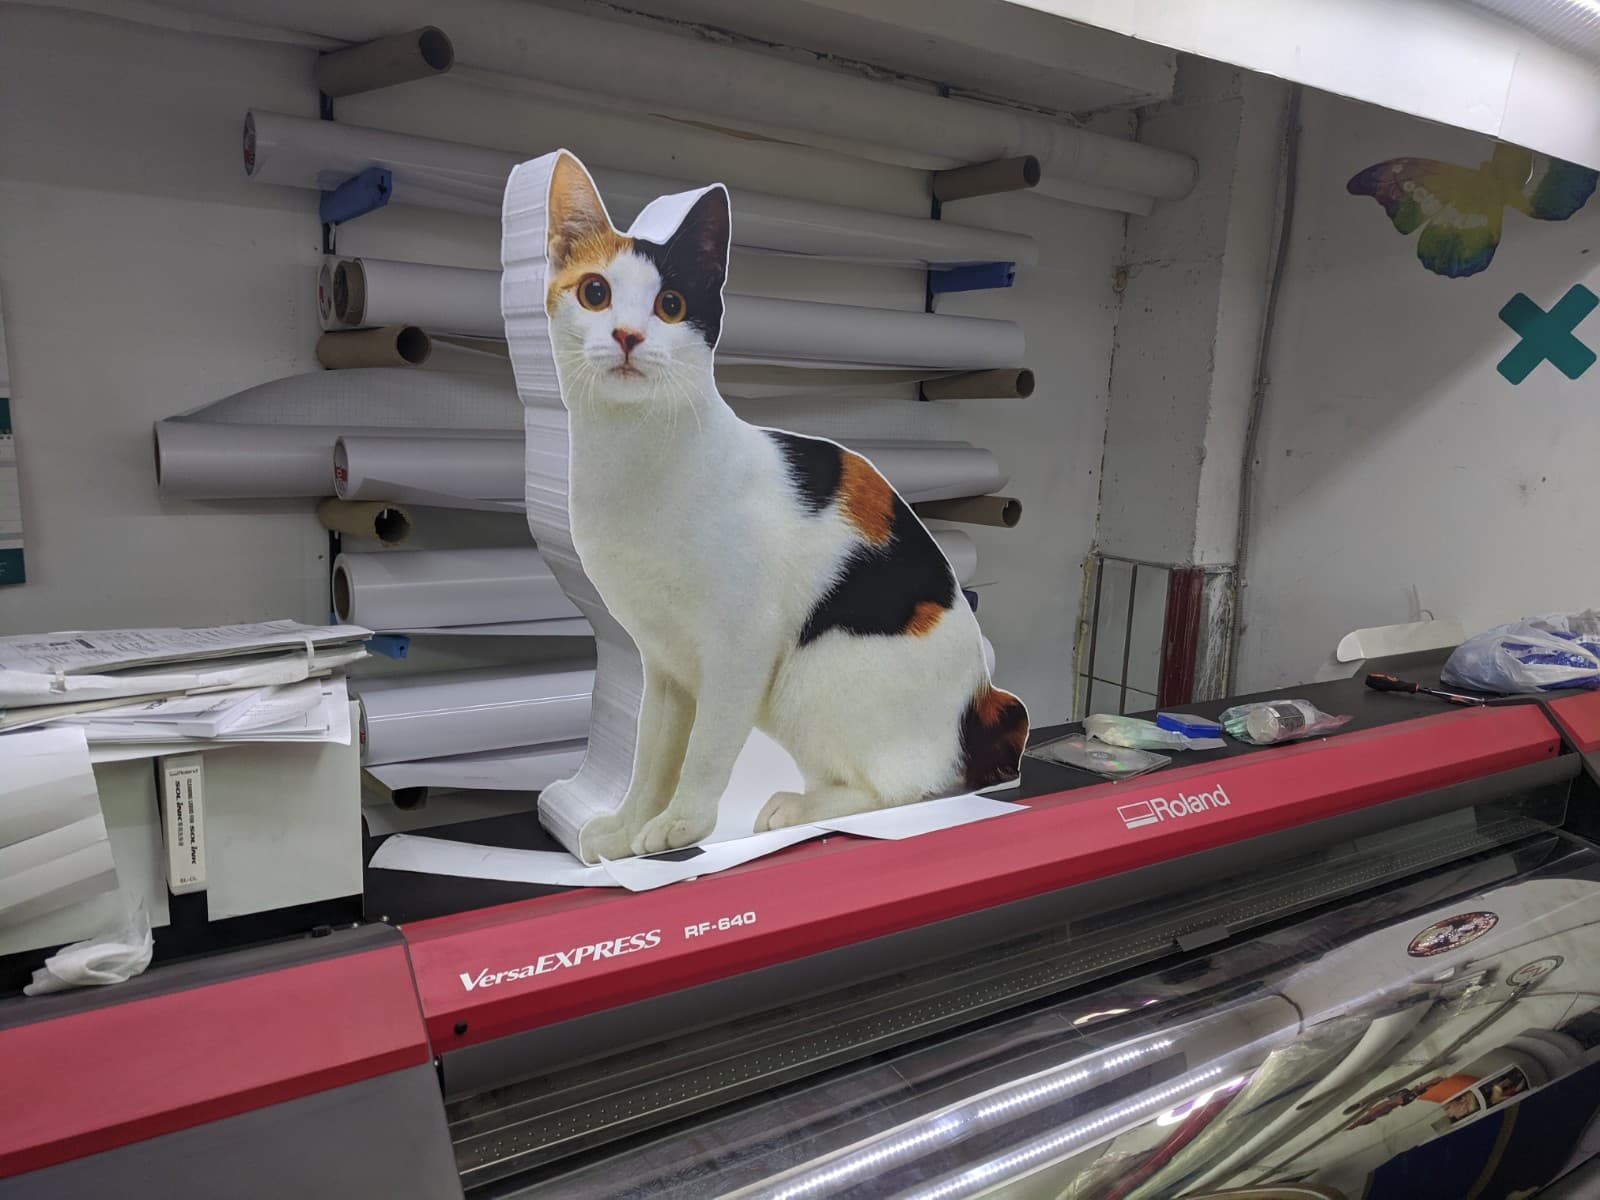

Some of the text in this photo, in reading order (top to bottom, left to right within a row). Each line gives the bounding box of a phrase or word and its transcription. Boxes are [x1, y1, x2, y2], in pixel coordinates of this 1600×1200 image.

[1150, 783, 1231, 822] Roland
[459, 911, 757, 992] VersaEXPRESS RF-640
